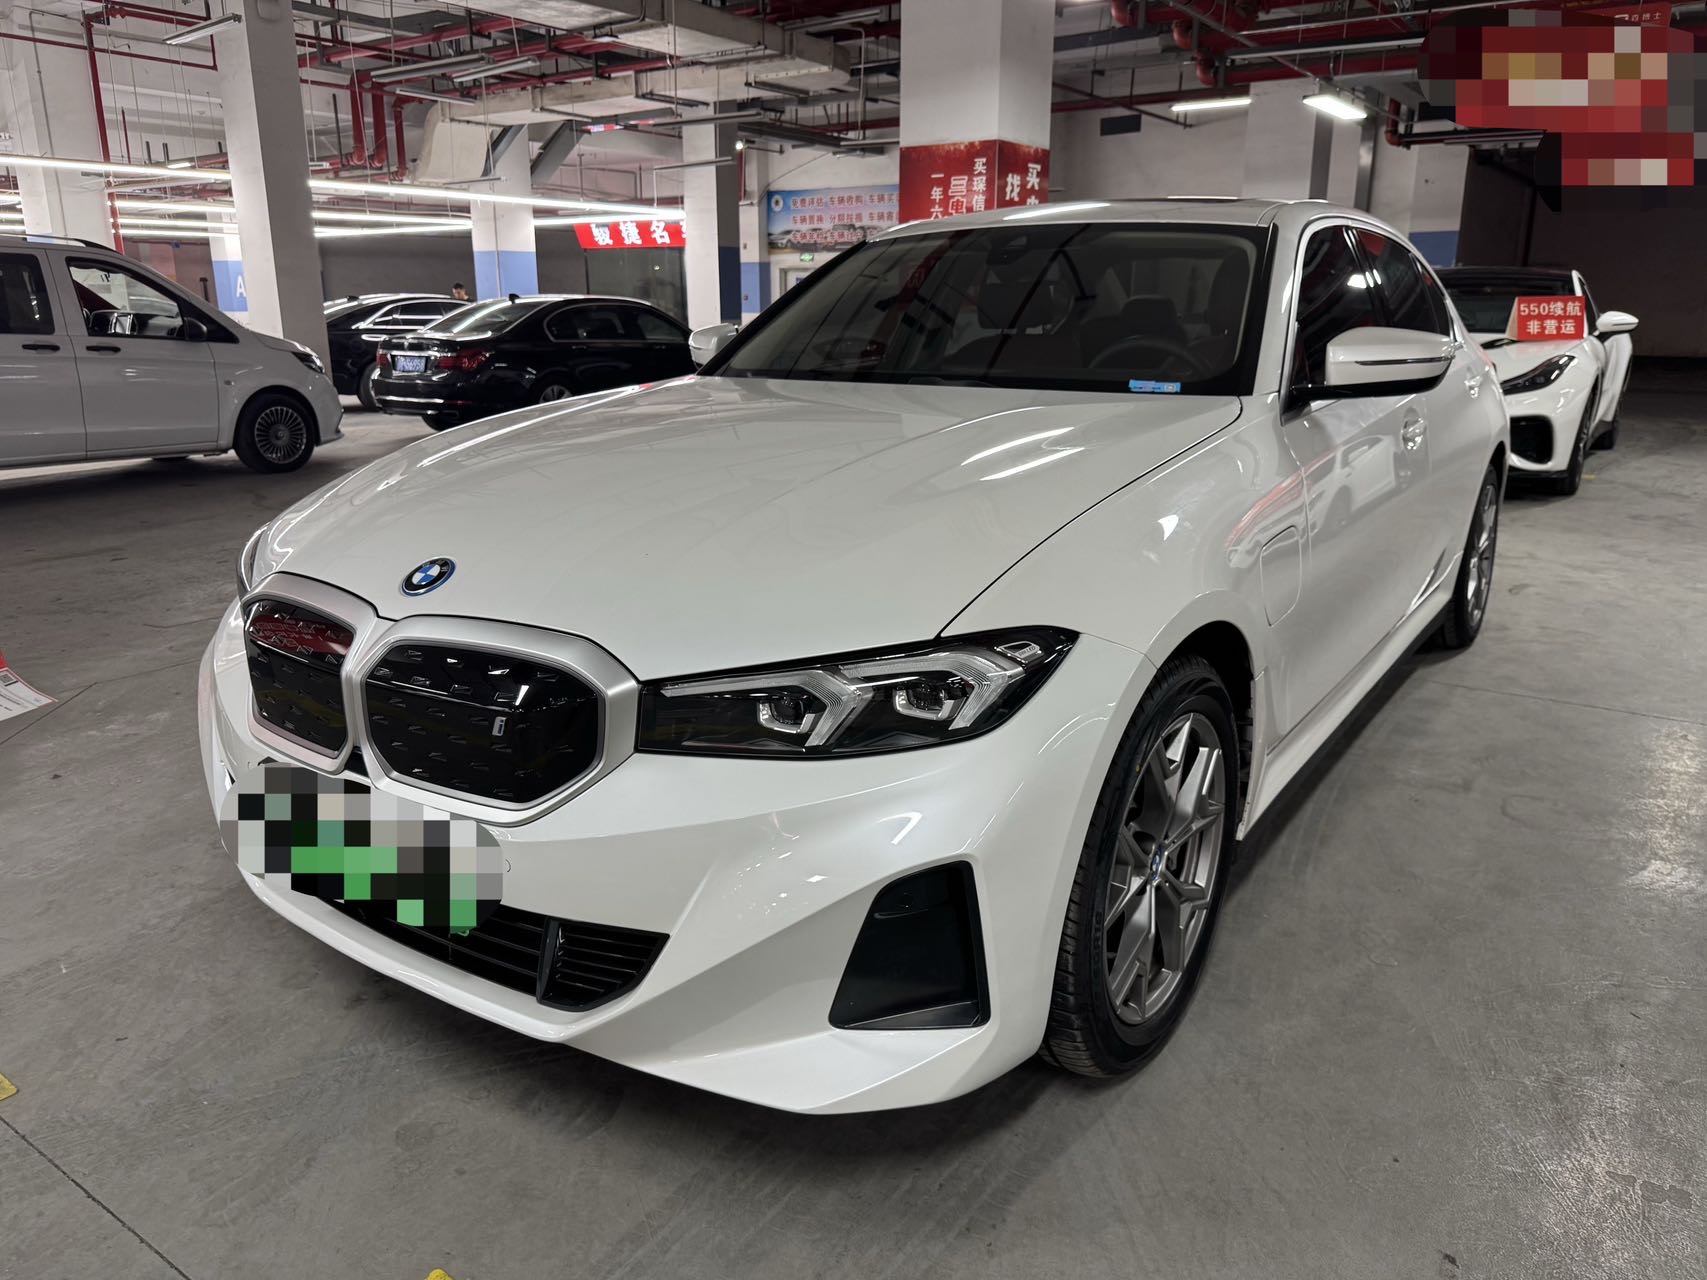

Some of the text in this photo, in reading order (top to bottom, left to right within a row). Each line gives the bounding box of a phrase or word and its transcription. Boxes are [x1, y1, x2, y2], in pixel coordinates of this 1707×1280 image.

[1005, 173, 1021, 201] 找
[236, 275, 247, 298] A
[1520, 301, 1582, 316] 550续航
[1526, 319, 1576, 335] 非营运
